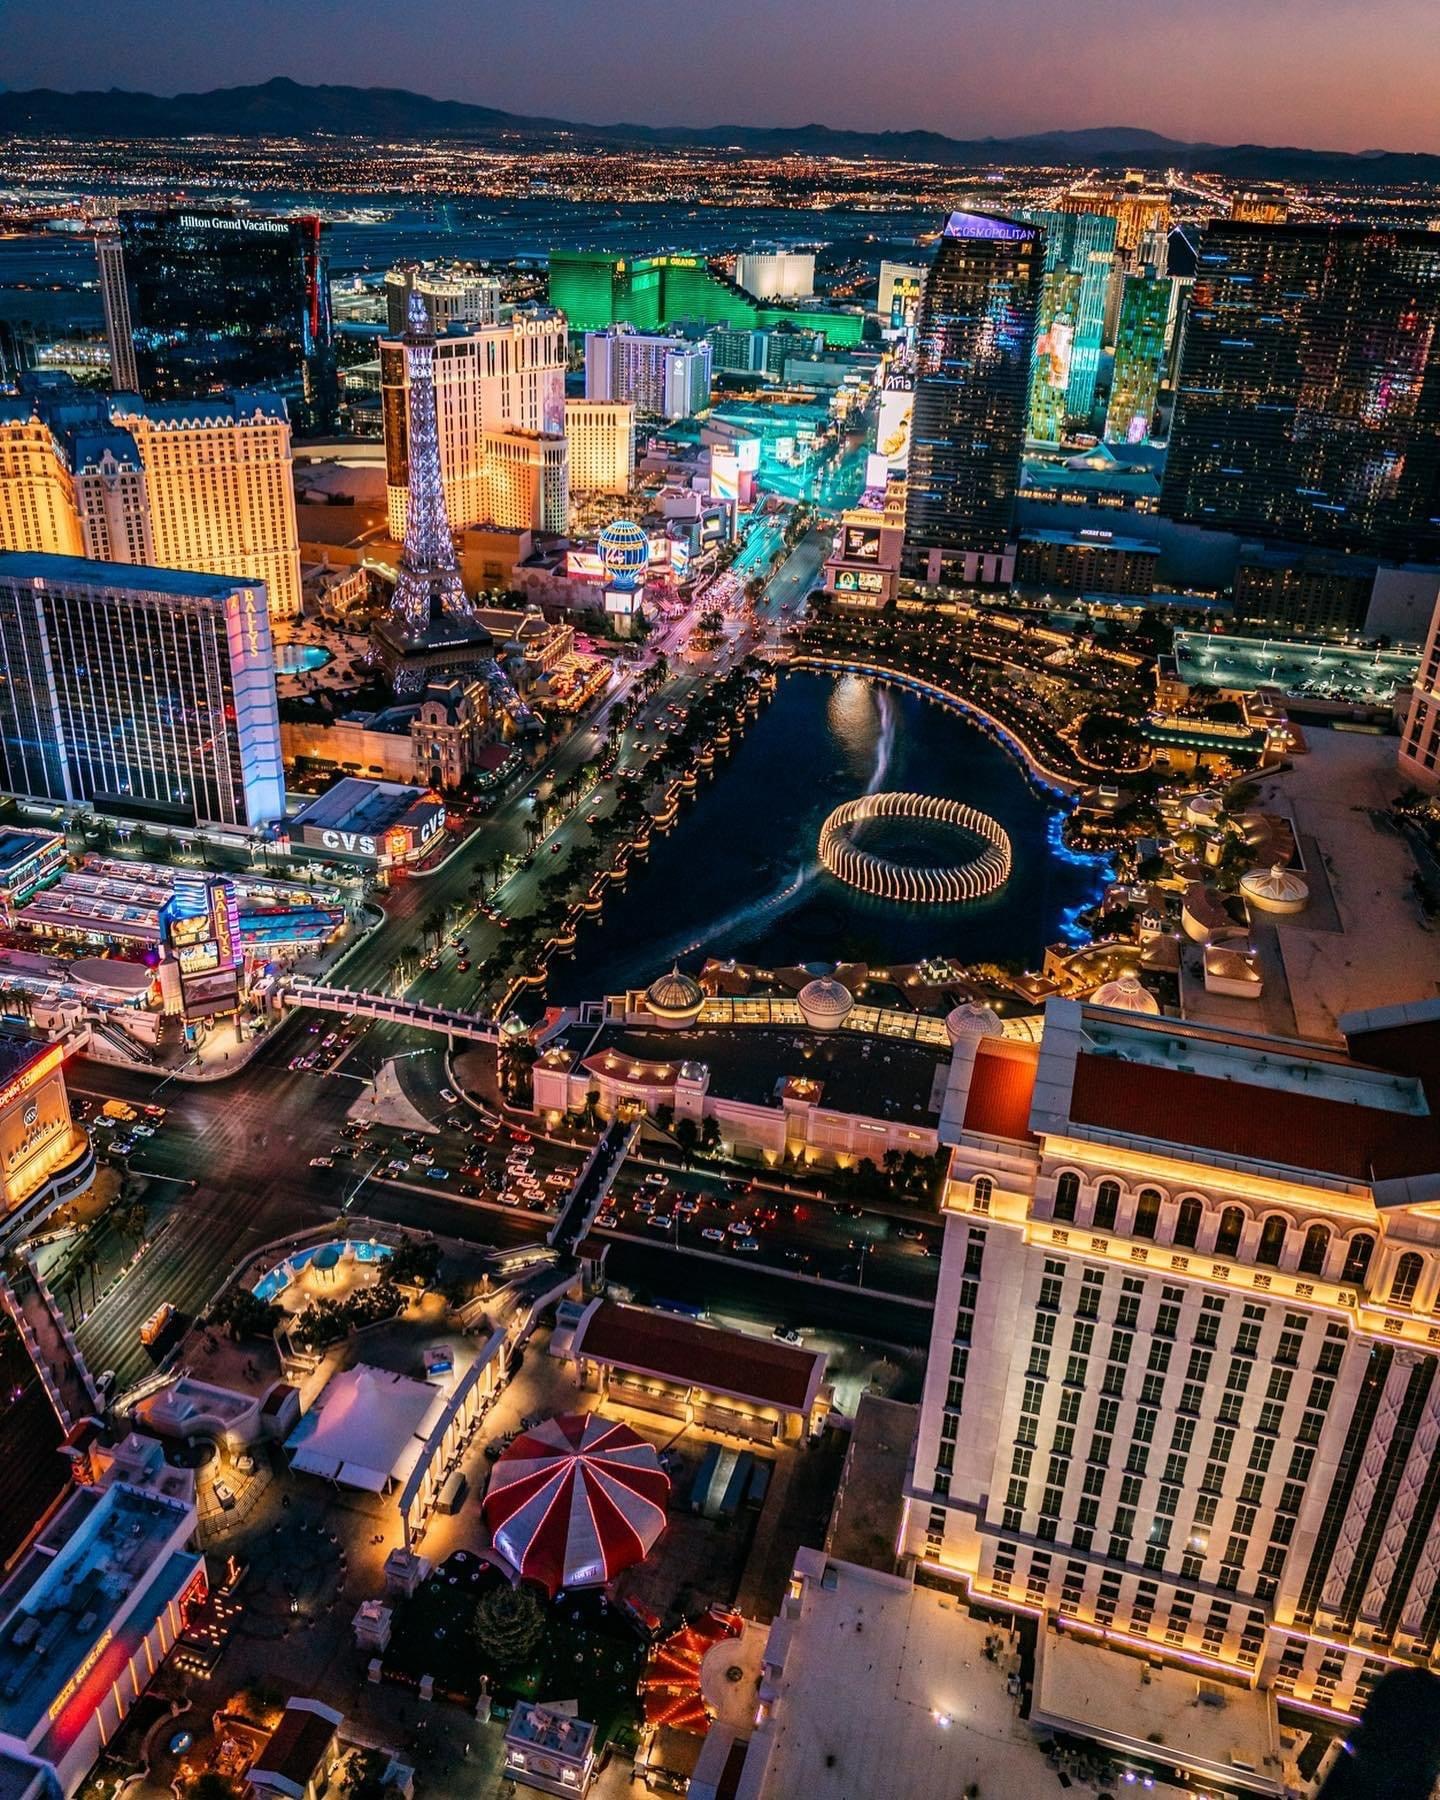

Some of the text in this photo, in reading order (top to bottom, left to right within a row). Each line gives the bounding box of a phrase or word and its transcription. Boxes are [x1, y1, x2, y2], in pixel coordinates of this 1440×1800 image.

[180, 216, 289, 232] Hilton Grand Vacations
[955, 226, 1035, 240] COSMOPOLITAN
[892, 286, 920, 297] MGM
[513, 317, 562, 340] planet
[885, 375, 912, 391] Aria
[421, 807, 446, 842] CVS
[322, 830, 375, 854] CVS
